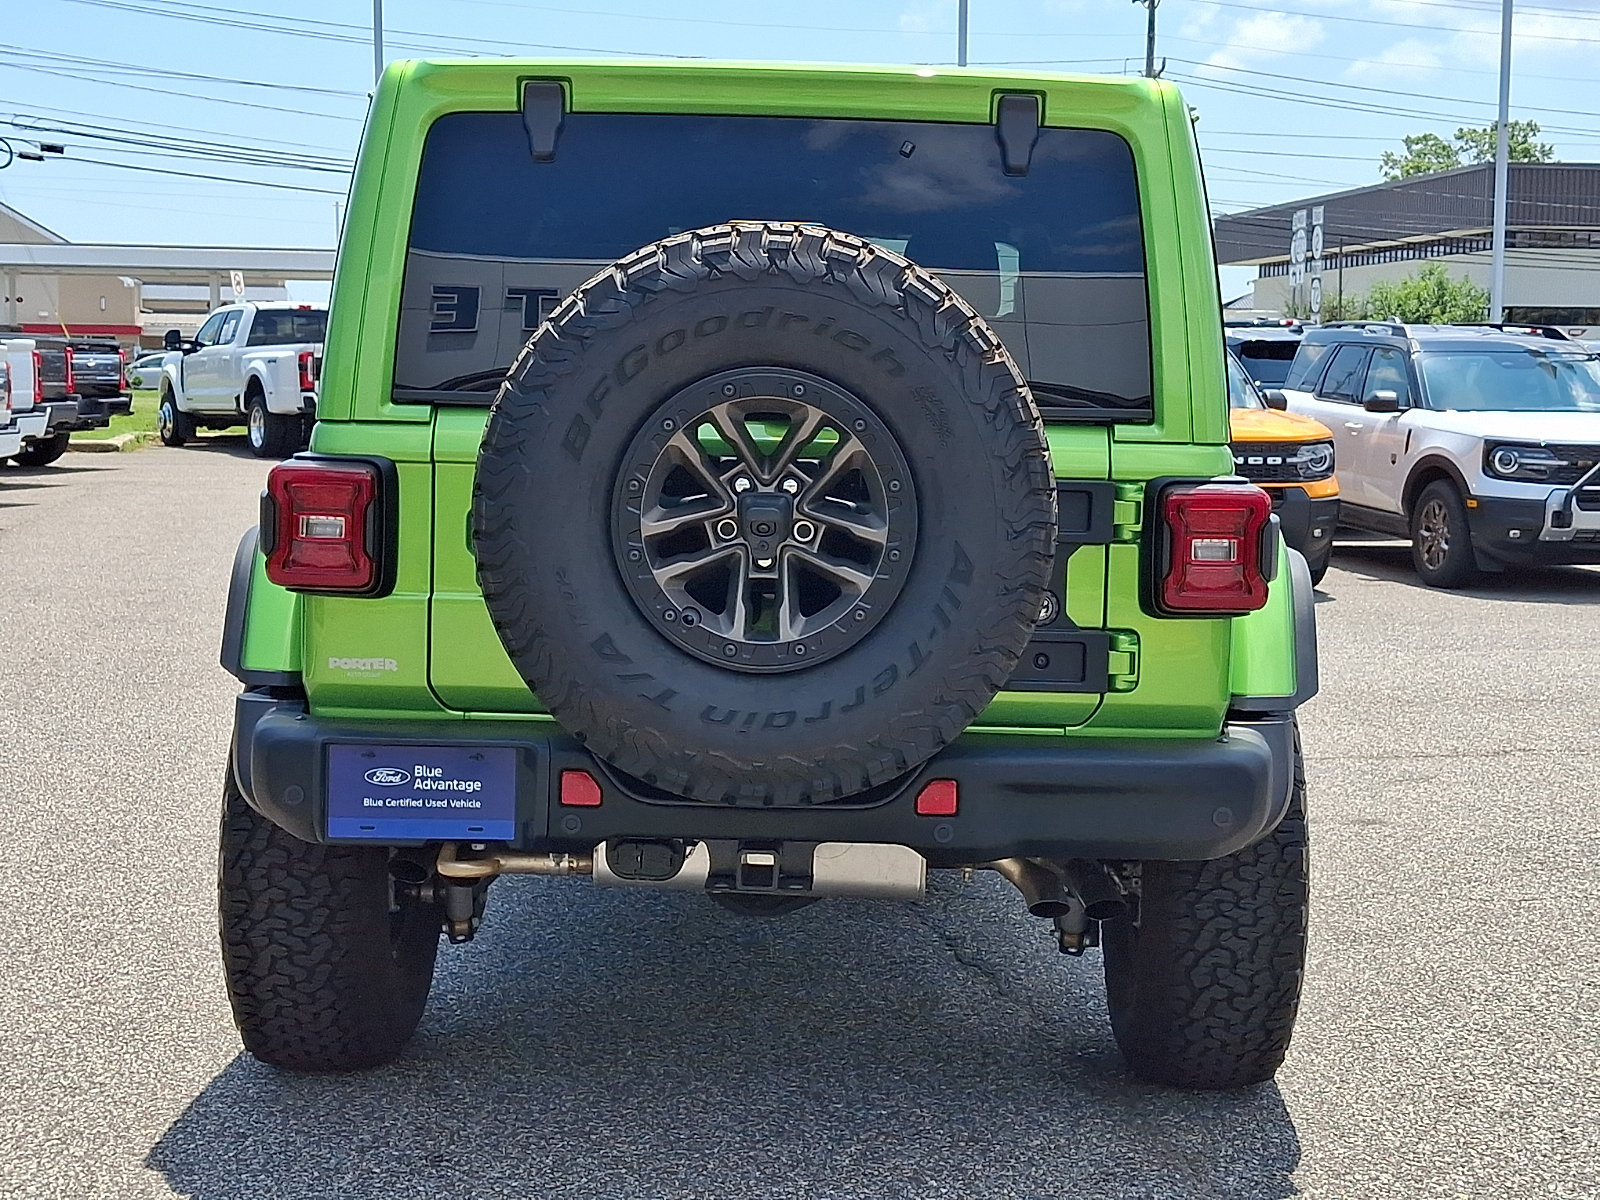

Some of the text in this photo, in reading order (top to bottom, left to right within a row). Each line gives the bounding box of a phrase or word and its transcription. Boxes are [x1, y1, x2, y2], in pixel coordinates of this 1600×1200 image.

[563, 305, 906, 462] BFGoodrich
[328, 657, 398, 672] PORTER
[372, 765, 443, 783] Ford Blue
[413, 778, 482, 793] Advantage
[363, 797, 482, 808] Blue Certified Used Vehicle
